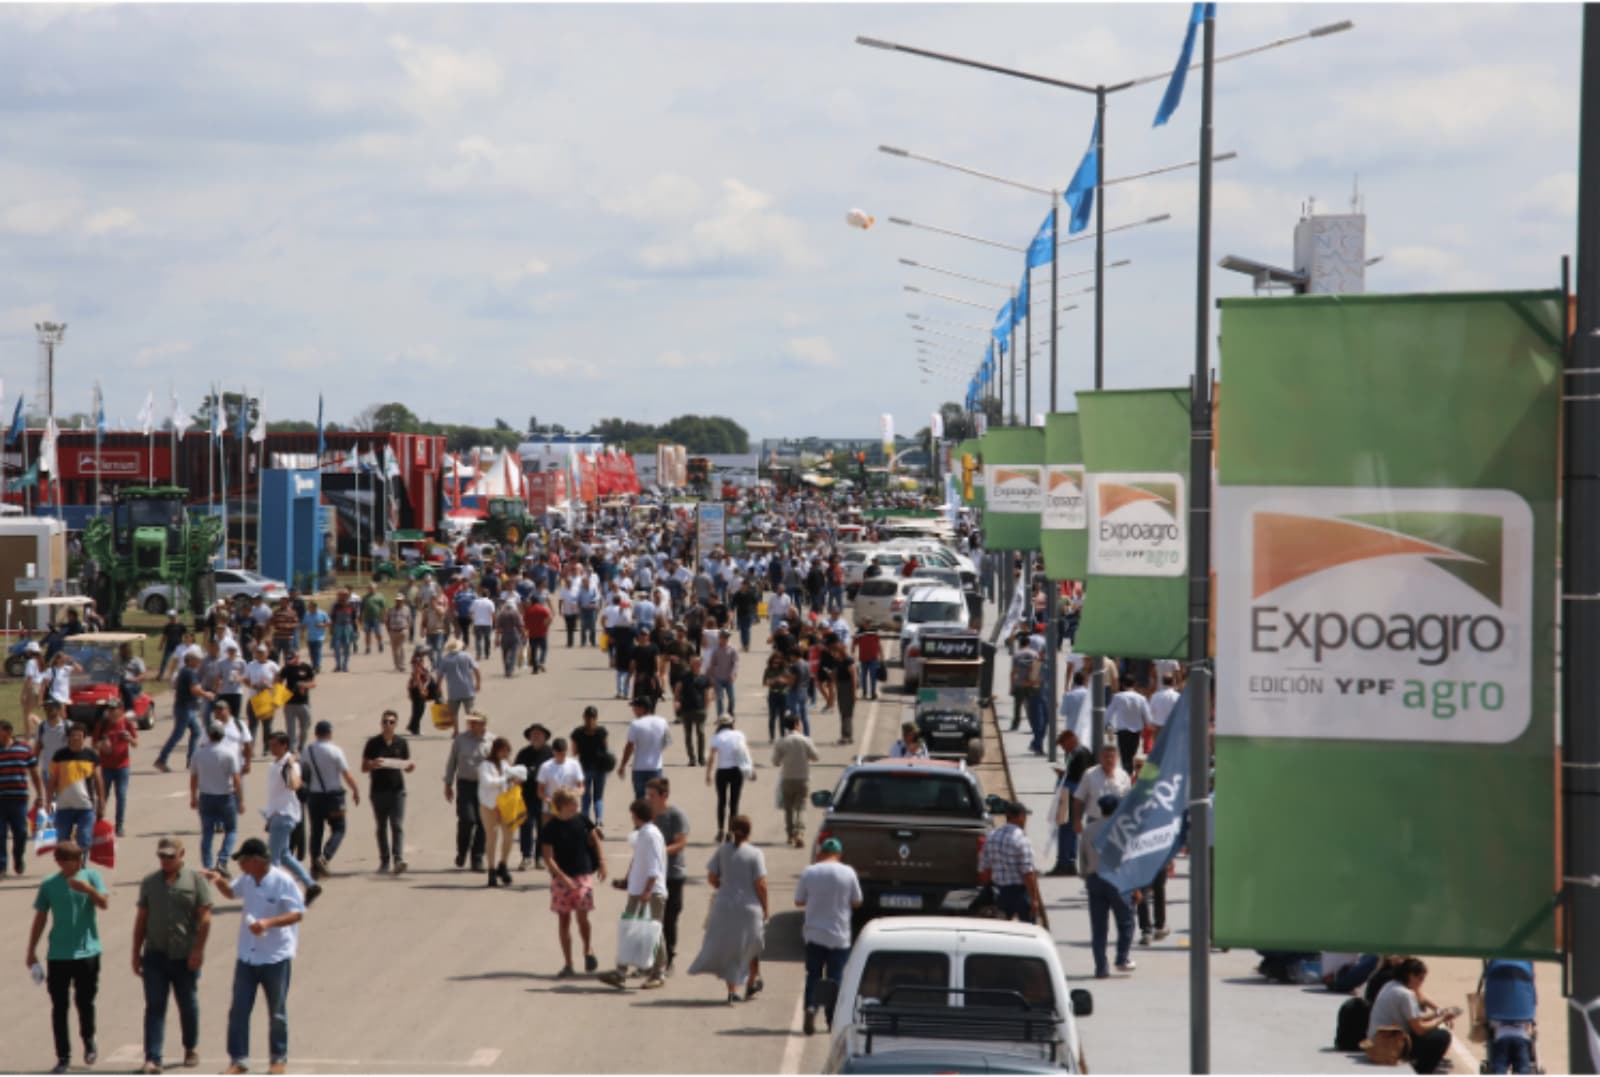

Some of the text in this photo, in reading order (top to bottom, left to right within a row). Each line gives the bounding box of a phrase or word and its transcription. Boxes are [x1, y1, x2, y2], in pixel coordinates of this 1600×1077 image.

[1100, 520, 1179, 547] Expoagro
[1251, 606, 1505, 667] Expoagro
[1250, 675, 1505, 719] EDICIÓN YPF agro
